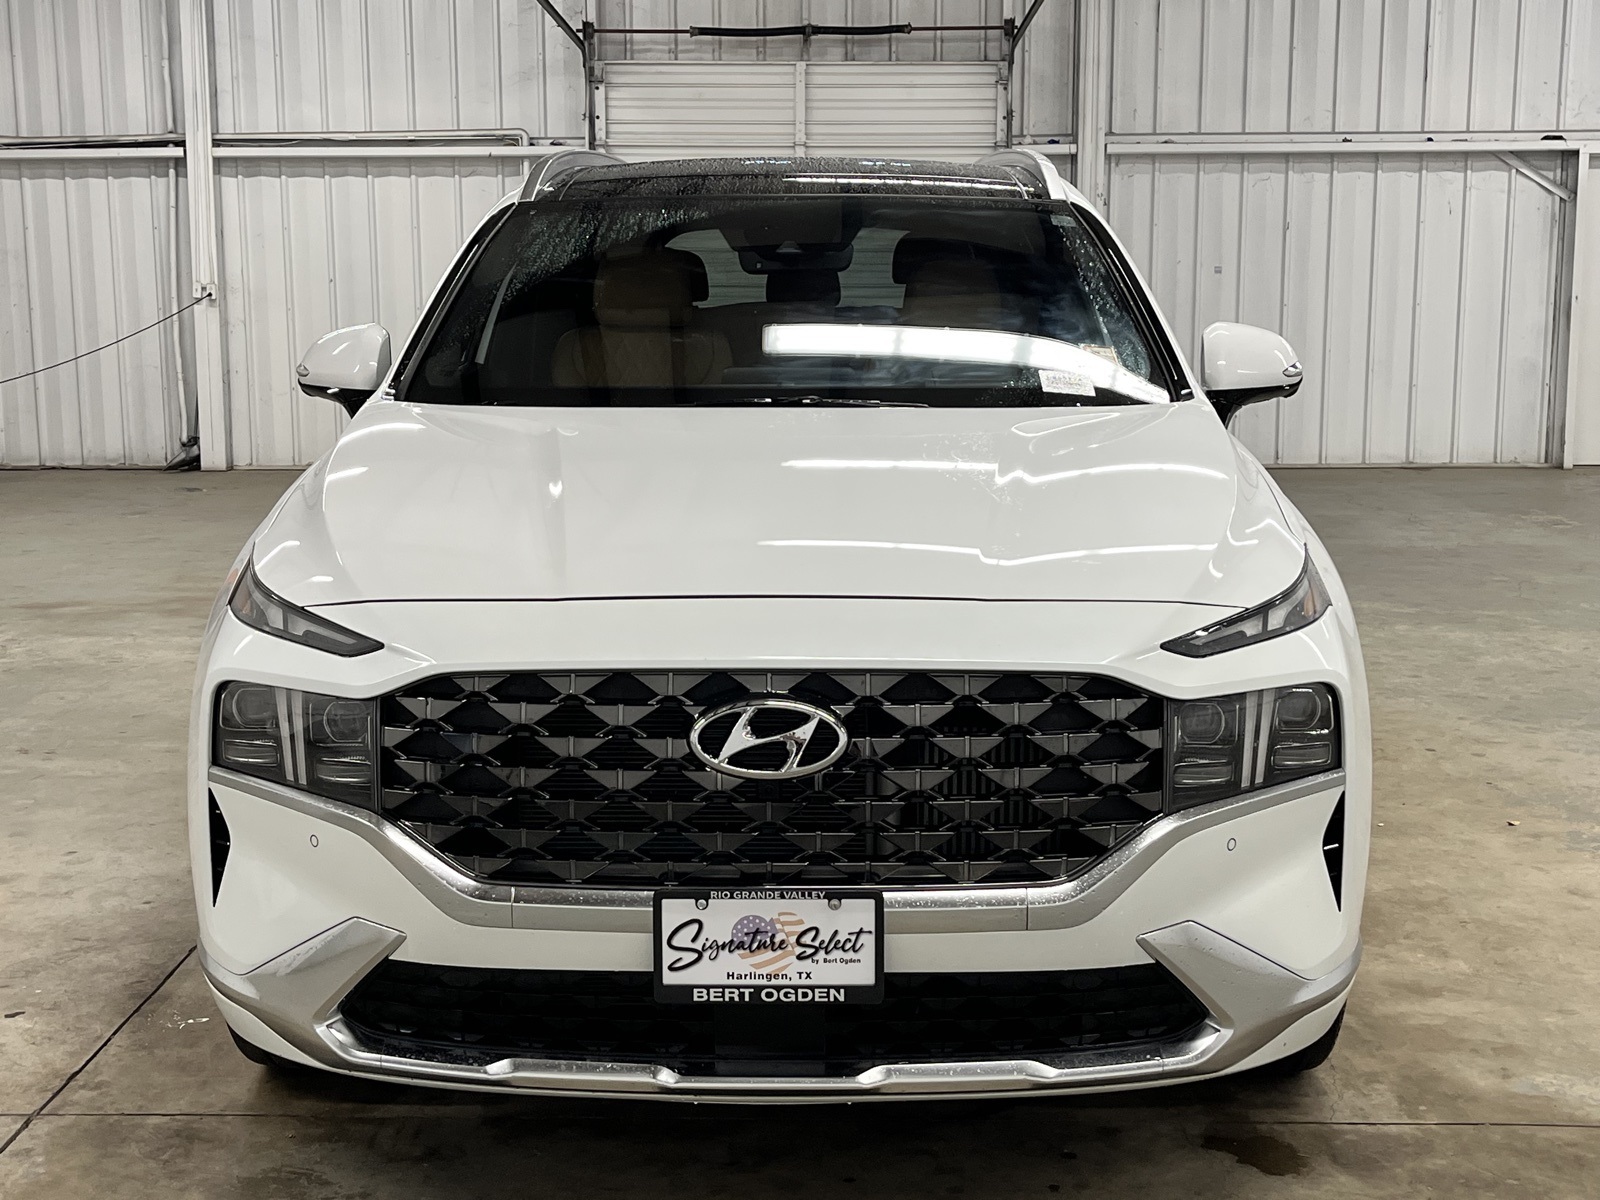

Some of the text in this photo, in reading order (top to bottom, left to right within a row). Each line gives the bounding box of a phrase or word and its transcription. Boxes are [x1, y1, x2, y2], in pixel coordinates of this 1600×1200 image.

[710, 891, 826, 900] RIO GRANDE VALLEY
[666, 918, 873, 972] Signature Select
[811, 957, 819, 965] by
[839, 957, 861, 965] Ogden
[726, 971, 813, 982] Harlingen, TX
[693, 988, 845, 1002] BERT OGDEN
